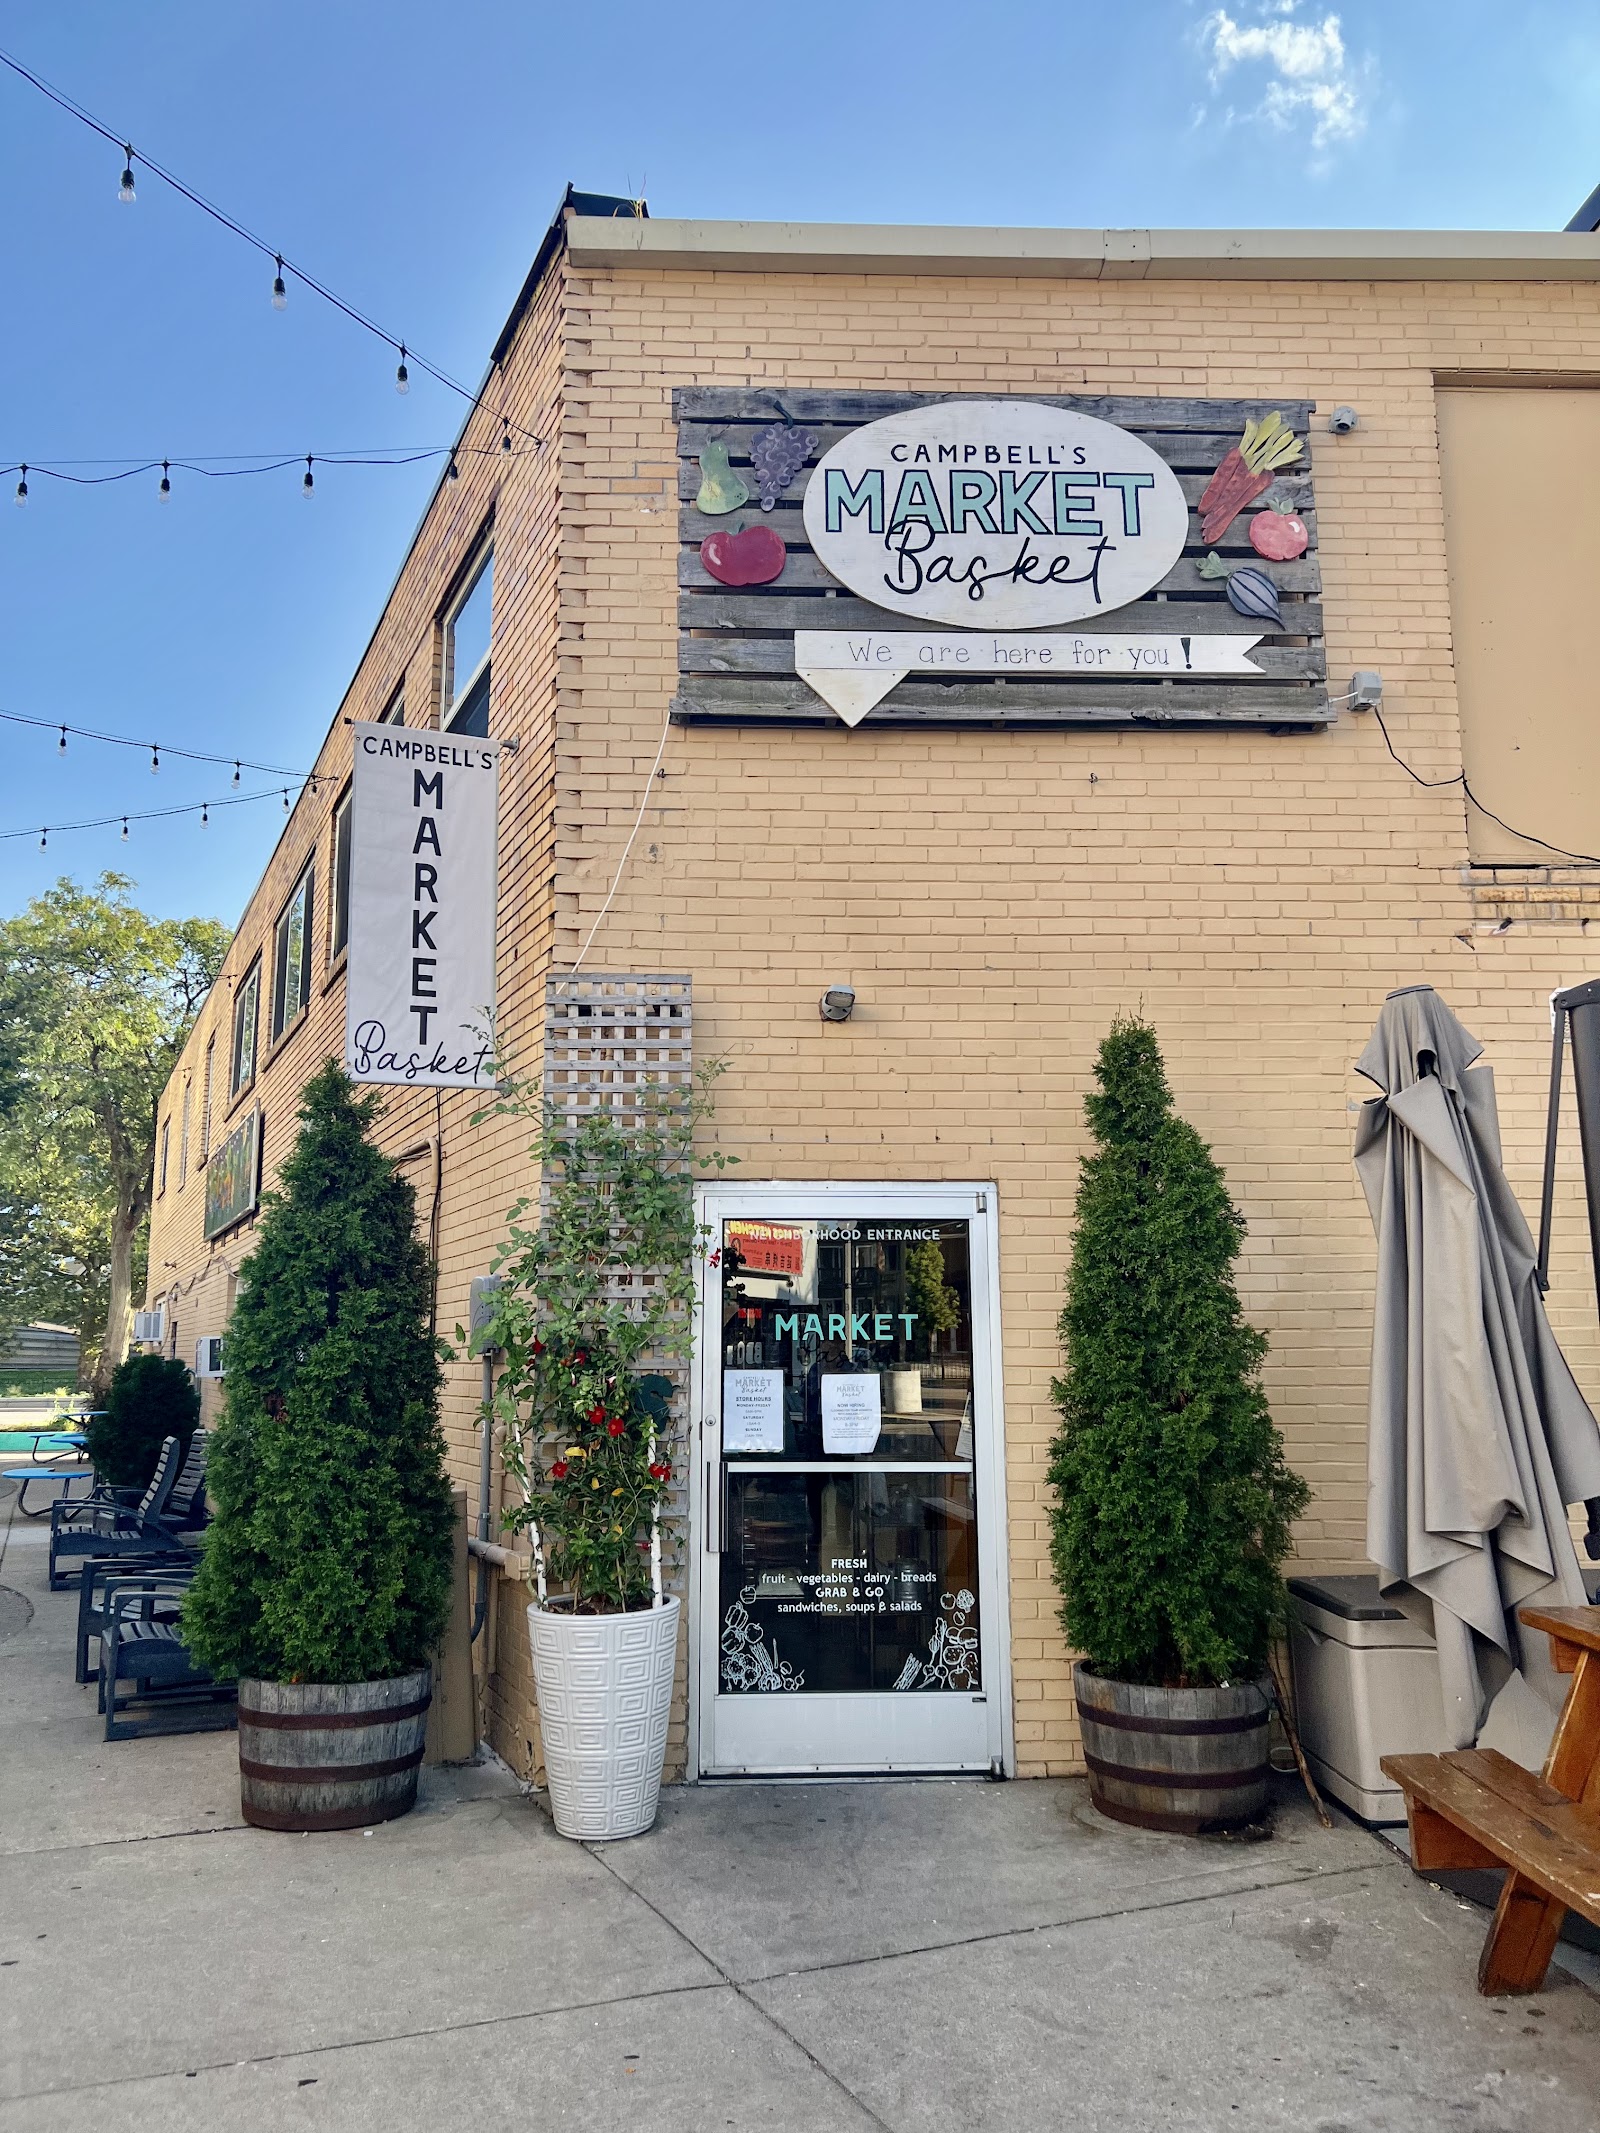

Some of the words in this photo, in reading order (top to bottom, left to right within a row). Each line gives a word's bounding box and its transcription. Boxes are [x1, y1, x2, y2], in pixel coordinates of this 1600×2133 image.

[890, 444, 1087, 465] CAMPBELL'S
[824, 468, 1154, 537] MARKET
[883, 519, 1117, 604] Basket
[848, 638, 892, 663] We
[918, 645, 970, 663] are
[993, 640, 1053, 664] here
[1072, 640, 1111, 664] for
[363, 736, 493, 770] CAMPBELL'S
[410, 769, 443, 1046] MARKET
[354, 1020, 494, 1084] Basket
[867, 1229, 940, 1241] ENTRANCE
[775, 1313, 919, 1341] MARKET
[736, 1379, 772, 1387] MARKET
[836, 1385, 865, 1393] MARKET
[831, 1559, 867, 1569] FRESH
[762, 1573, 786, 1584] fruit
[796, 1573, 853, 1586] vegetables
[863, 1572, 891, 1585] dairy
[901, 1572, 937, 1583] breads
[815, 1587, 847, 1598] GRAB
[852, 1587, 860, 1597] &
[865, 1587, 884, 1598] GO
[777, 1601, 842, 1613] sandwiches,
[845, 1603, 876, 1614] soups
[879, 1601, 887, 1613] &
[890, 1600, 923, 1611] salads
